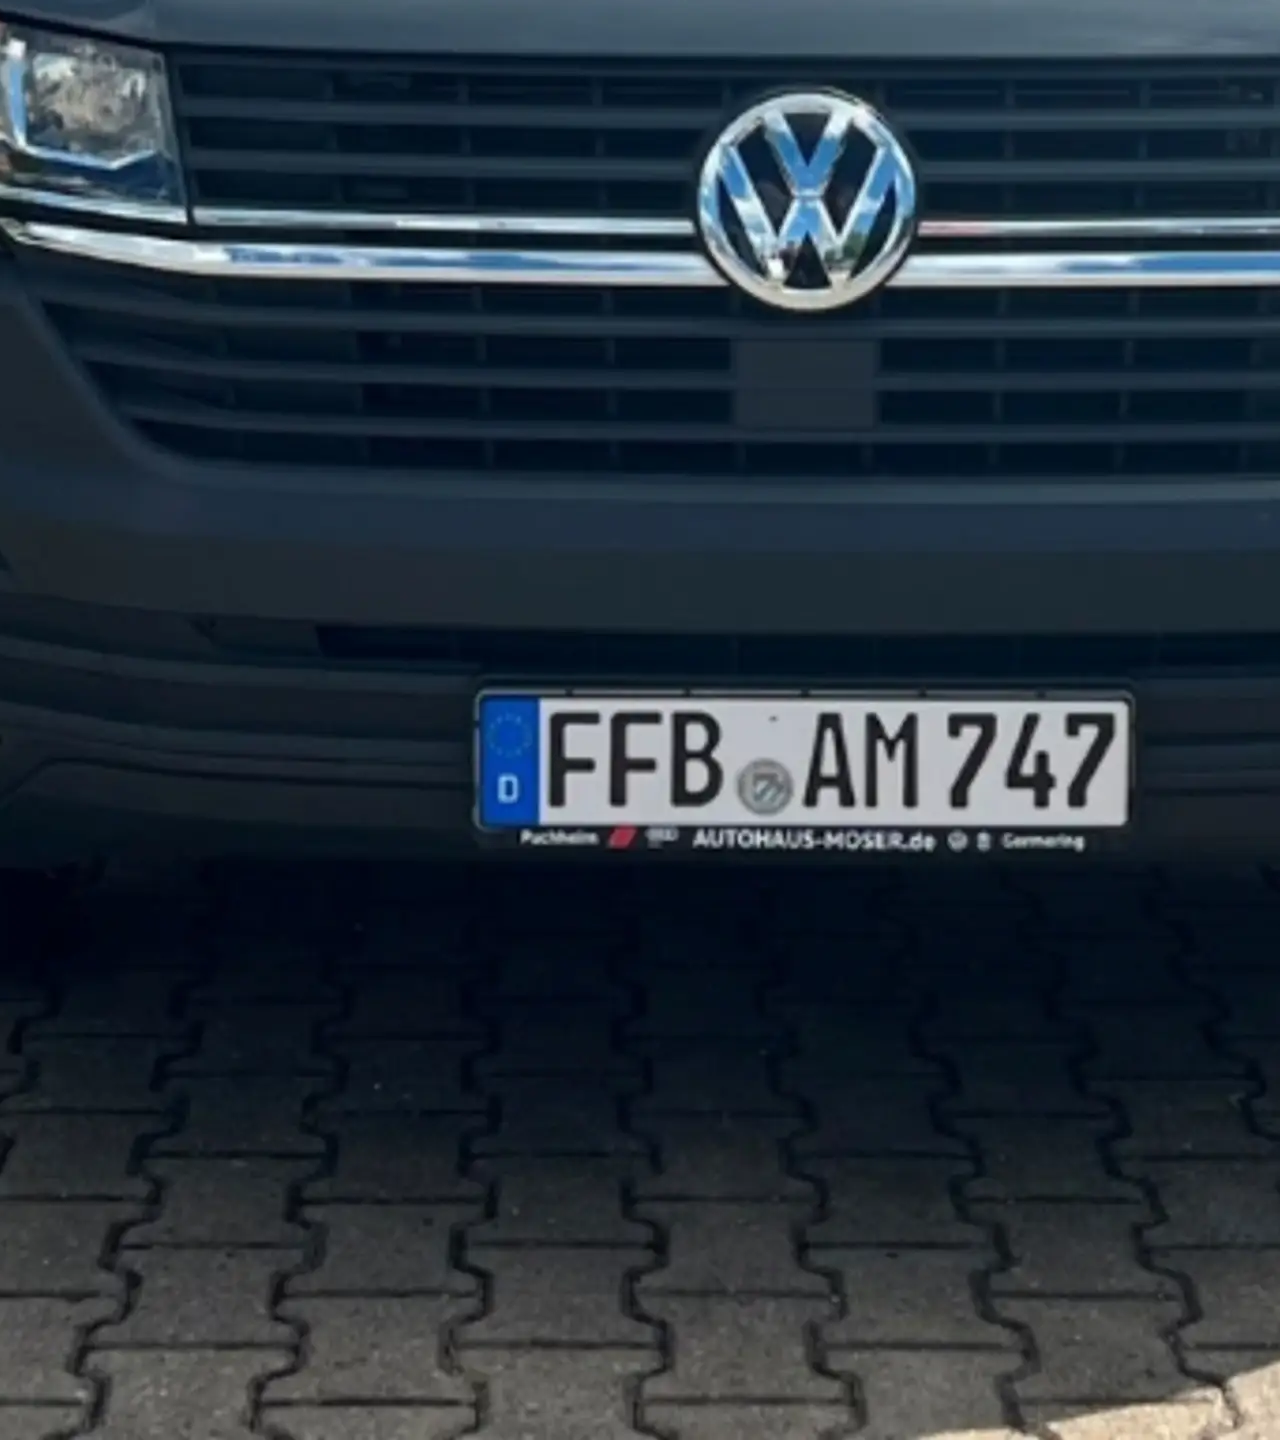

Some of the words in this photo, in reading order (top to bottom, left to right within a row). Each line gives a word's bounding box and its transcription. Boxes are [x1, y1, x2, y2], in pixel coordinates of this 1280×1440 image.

[697, 92, 917, 311] VW
[497, 773, 520, 803] D
[548, 712, 724, 808] FFB
[803, 712, 919, 809] AM
[947, 712, 1116, 809] 747
